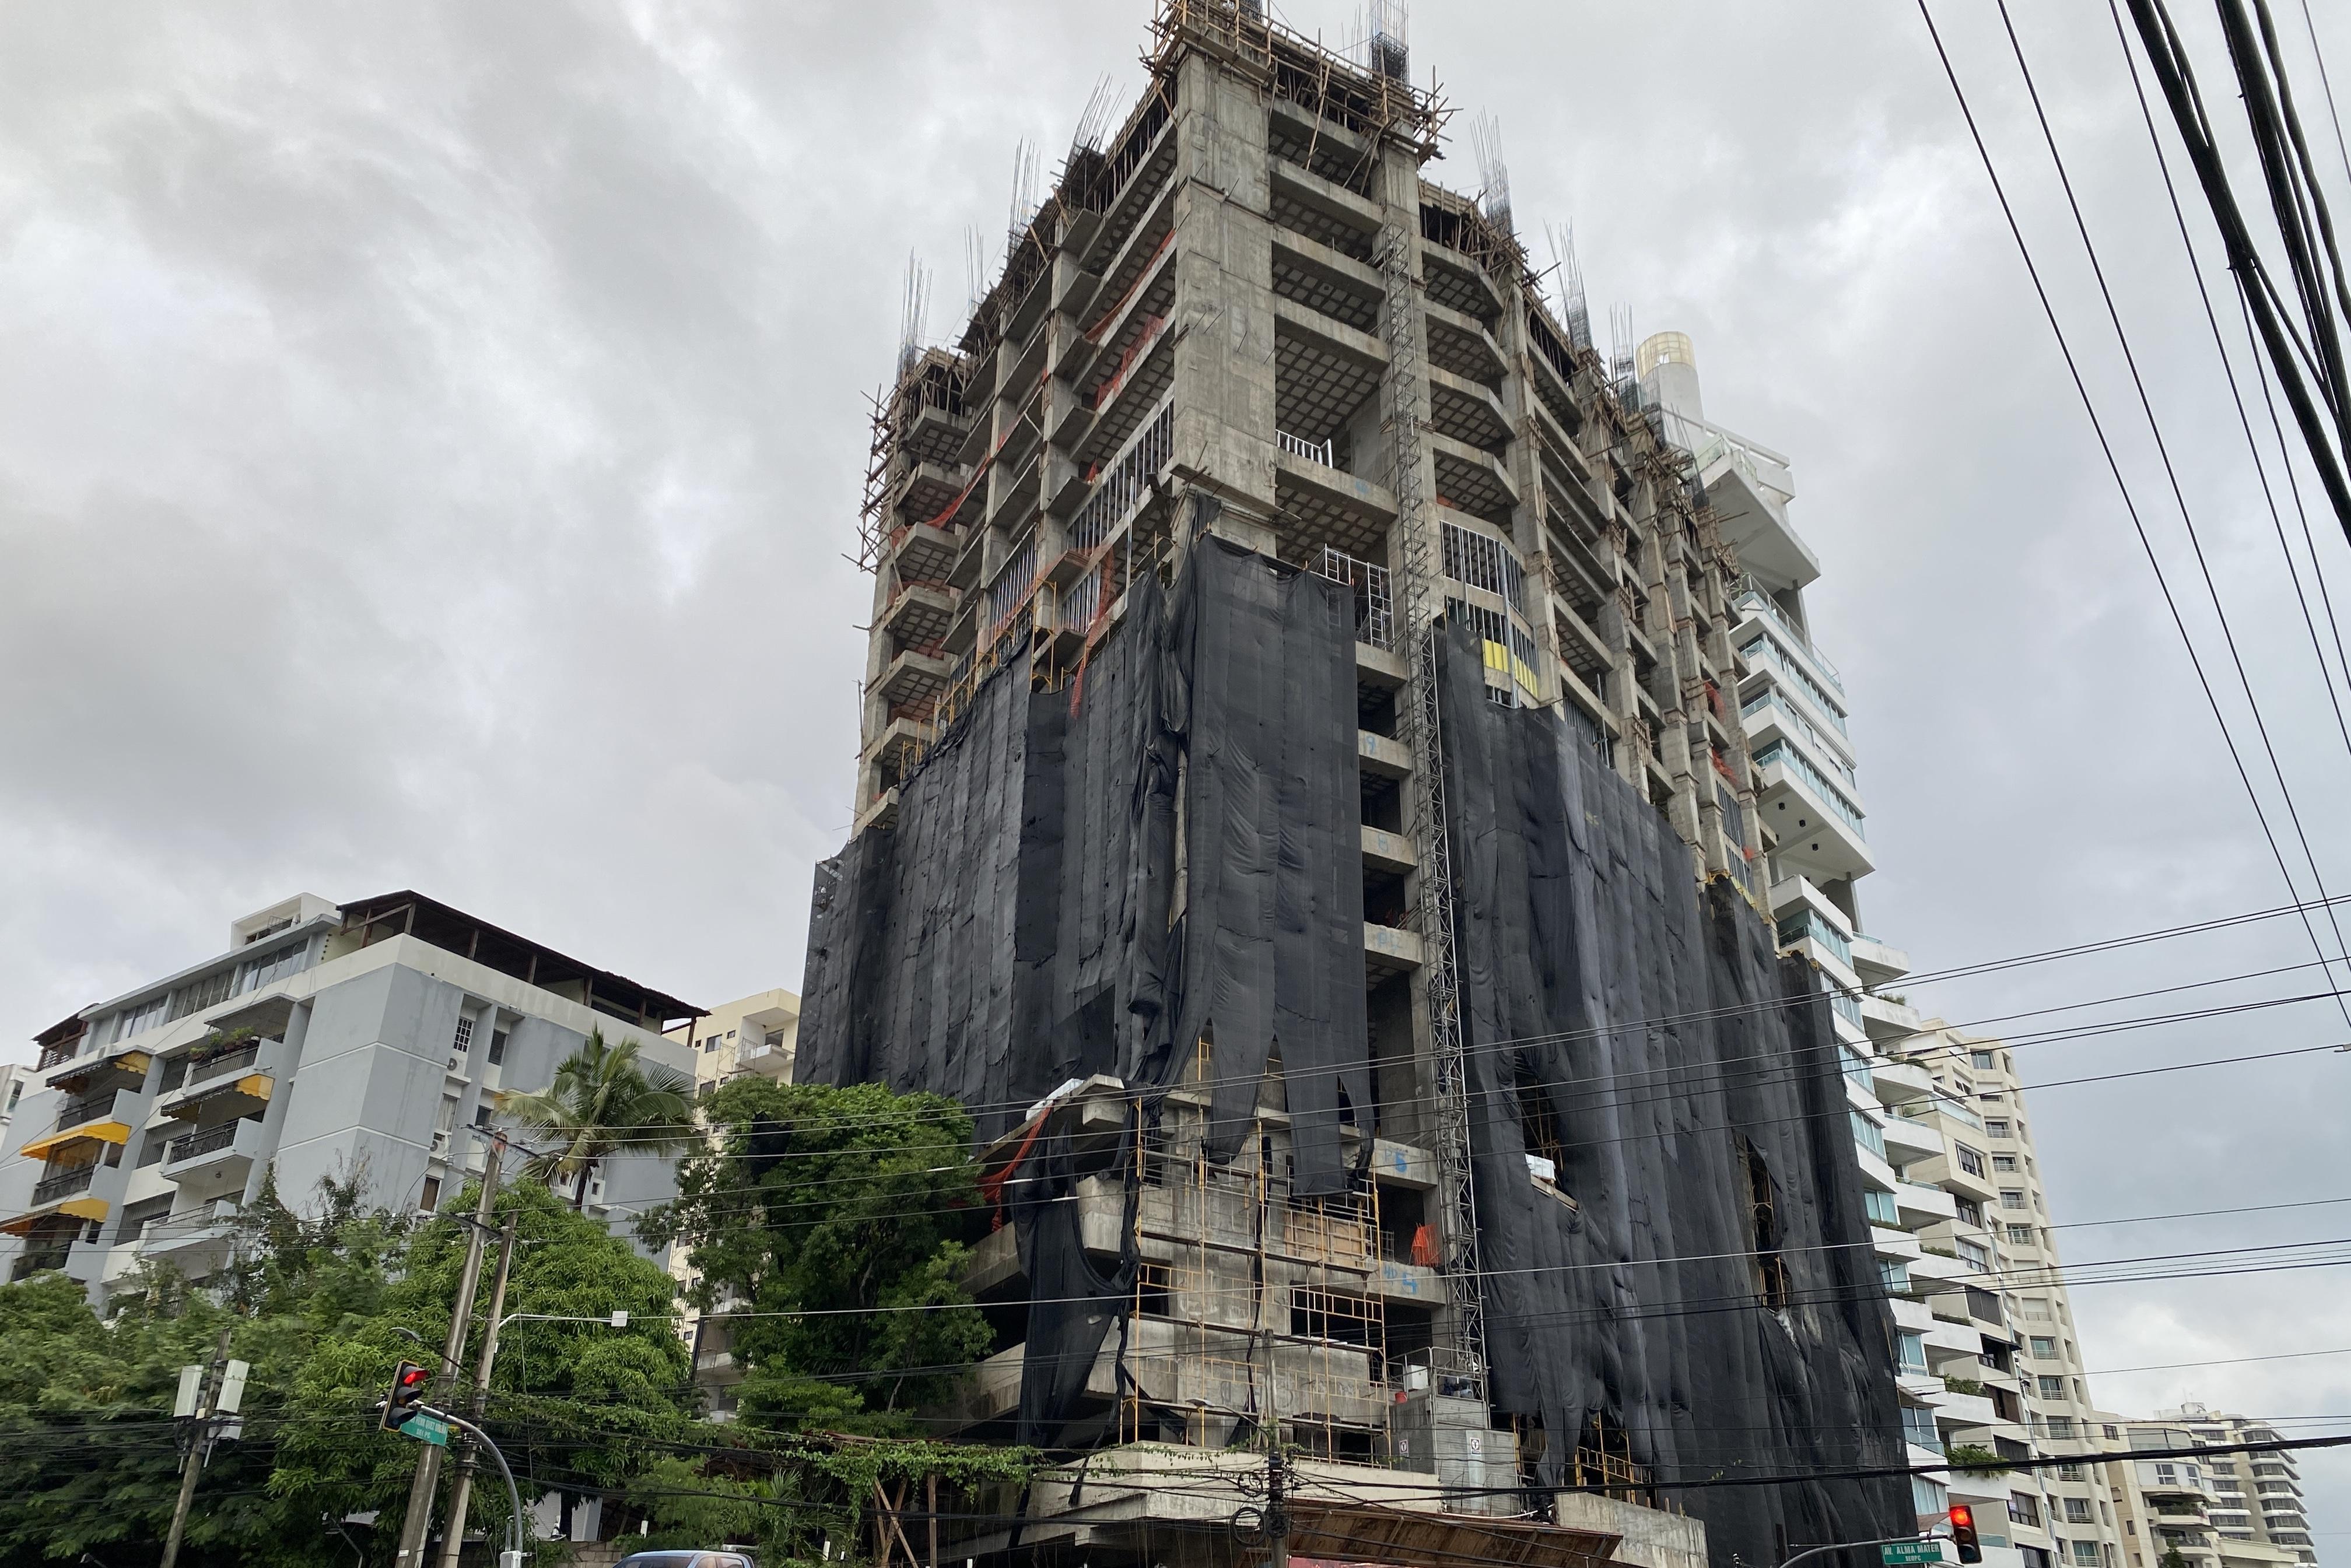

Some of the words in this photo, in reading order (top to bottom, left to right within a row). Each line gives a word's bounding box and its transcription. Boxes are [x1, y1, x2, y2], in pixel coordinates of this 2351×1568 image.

[1884, 1546, 1893, 1555] AV.
[1897, 1545, 1915, 1555] ALMA
[1917, 1544, 1940, 1553] MATER
